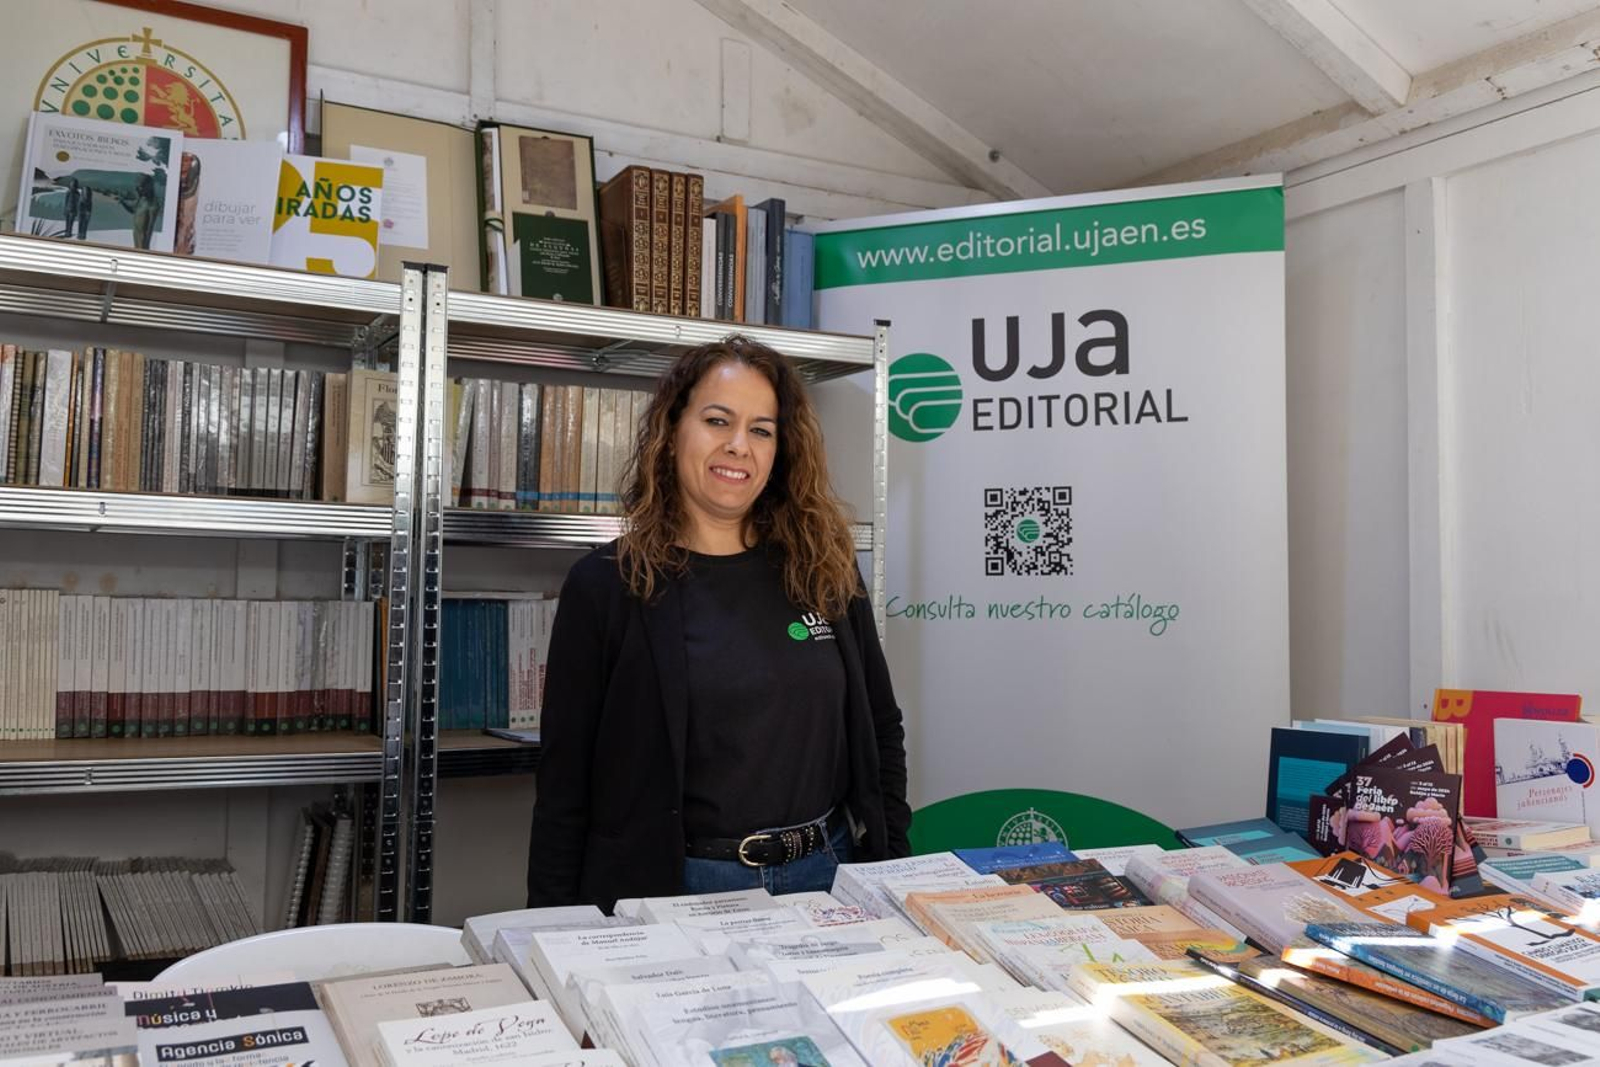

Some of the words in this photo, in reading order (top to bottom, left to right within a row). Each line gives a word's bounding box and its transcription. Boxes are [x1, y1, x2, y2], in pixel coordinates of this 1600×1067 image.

[296, 177, 372, 205] AÑOS
[202, 213, 235, 226] para
[239, 215, 261, 226] ver
[204, 201, 256, 216] dibujar
[857, 215, 1207, 269] www.editorial.ujaen.es
[973, 388, 1189, 432] EDITORIAL
[885, 594, 976, 621] Consulta
[986, 597, 1072, 621] nuestro
[1082, 592, 1181, 637] catálogo
[1356, 775, 1373, 787] 37
[1356, 785, 1383, 796] Feria
[1355, 794, 1371, 803] del
[1373, 794, 1399, 806] libro
[160, 1038, 236, 1059] Agencia
[241, 1029, 304, 1048] Sónica
[403, 1026, 460, 1046] Lope
[465, 1021, 485, 1037] de
[495, 1014, 546, 1038] Vega
